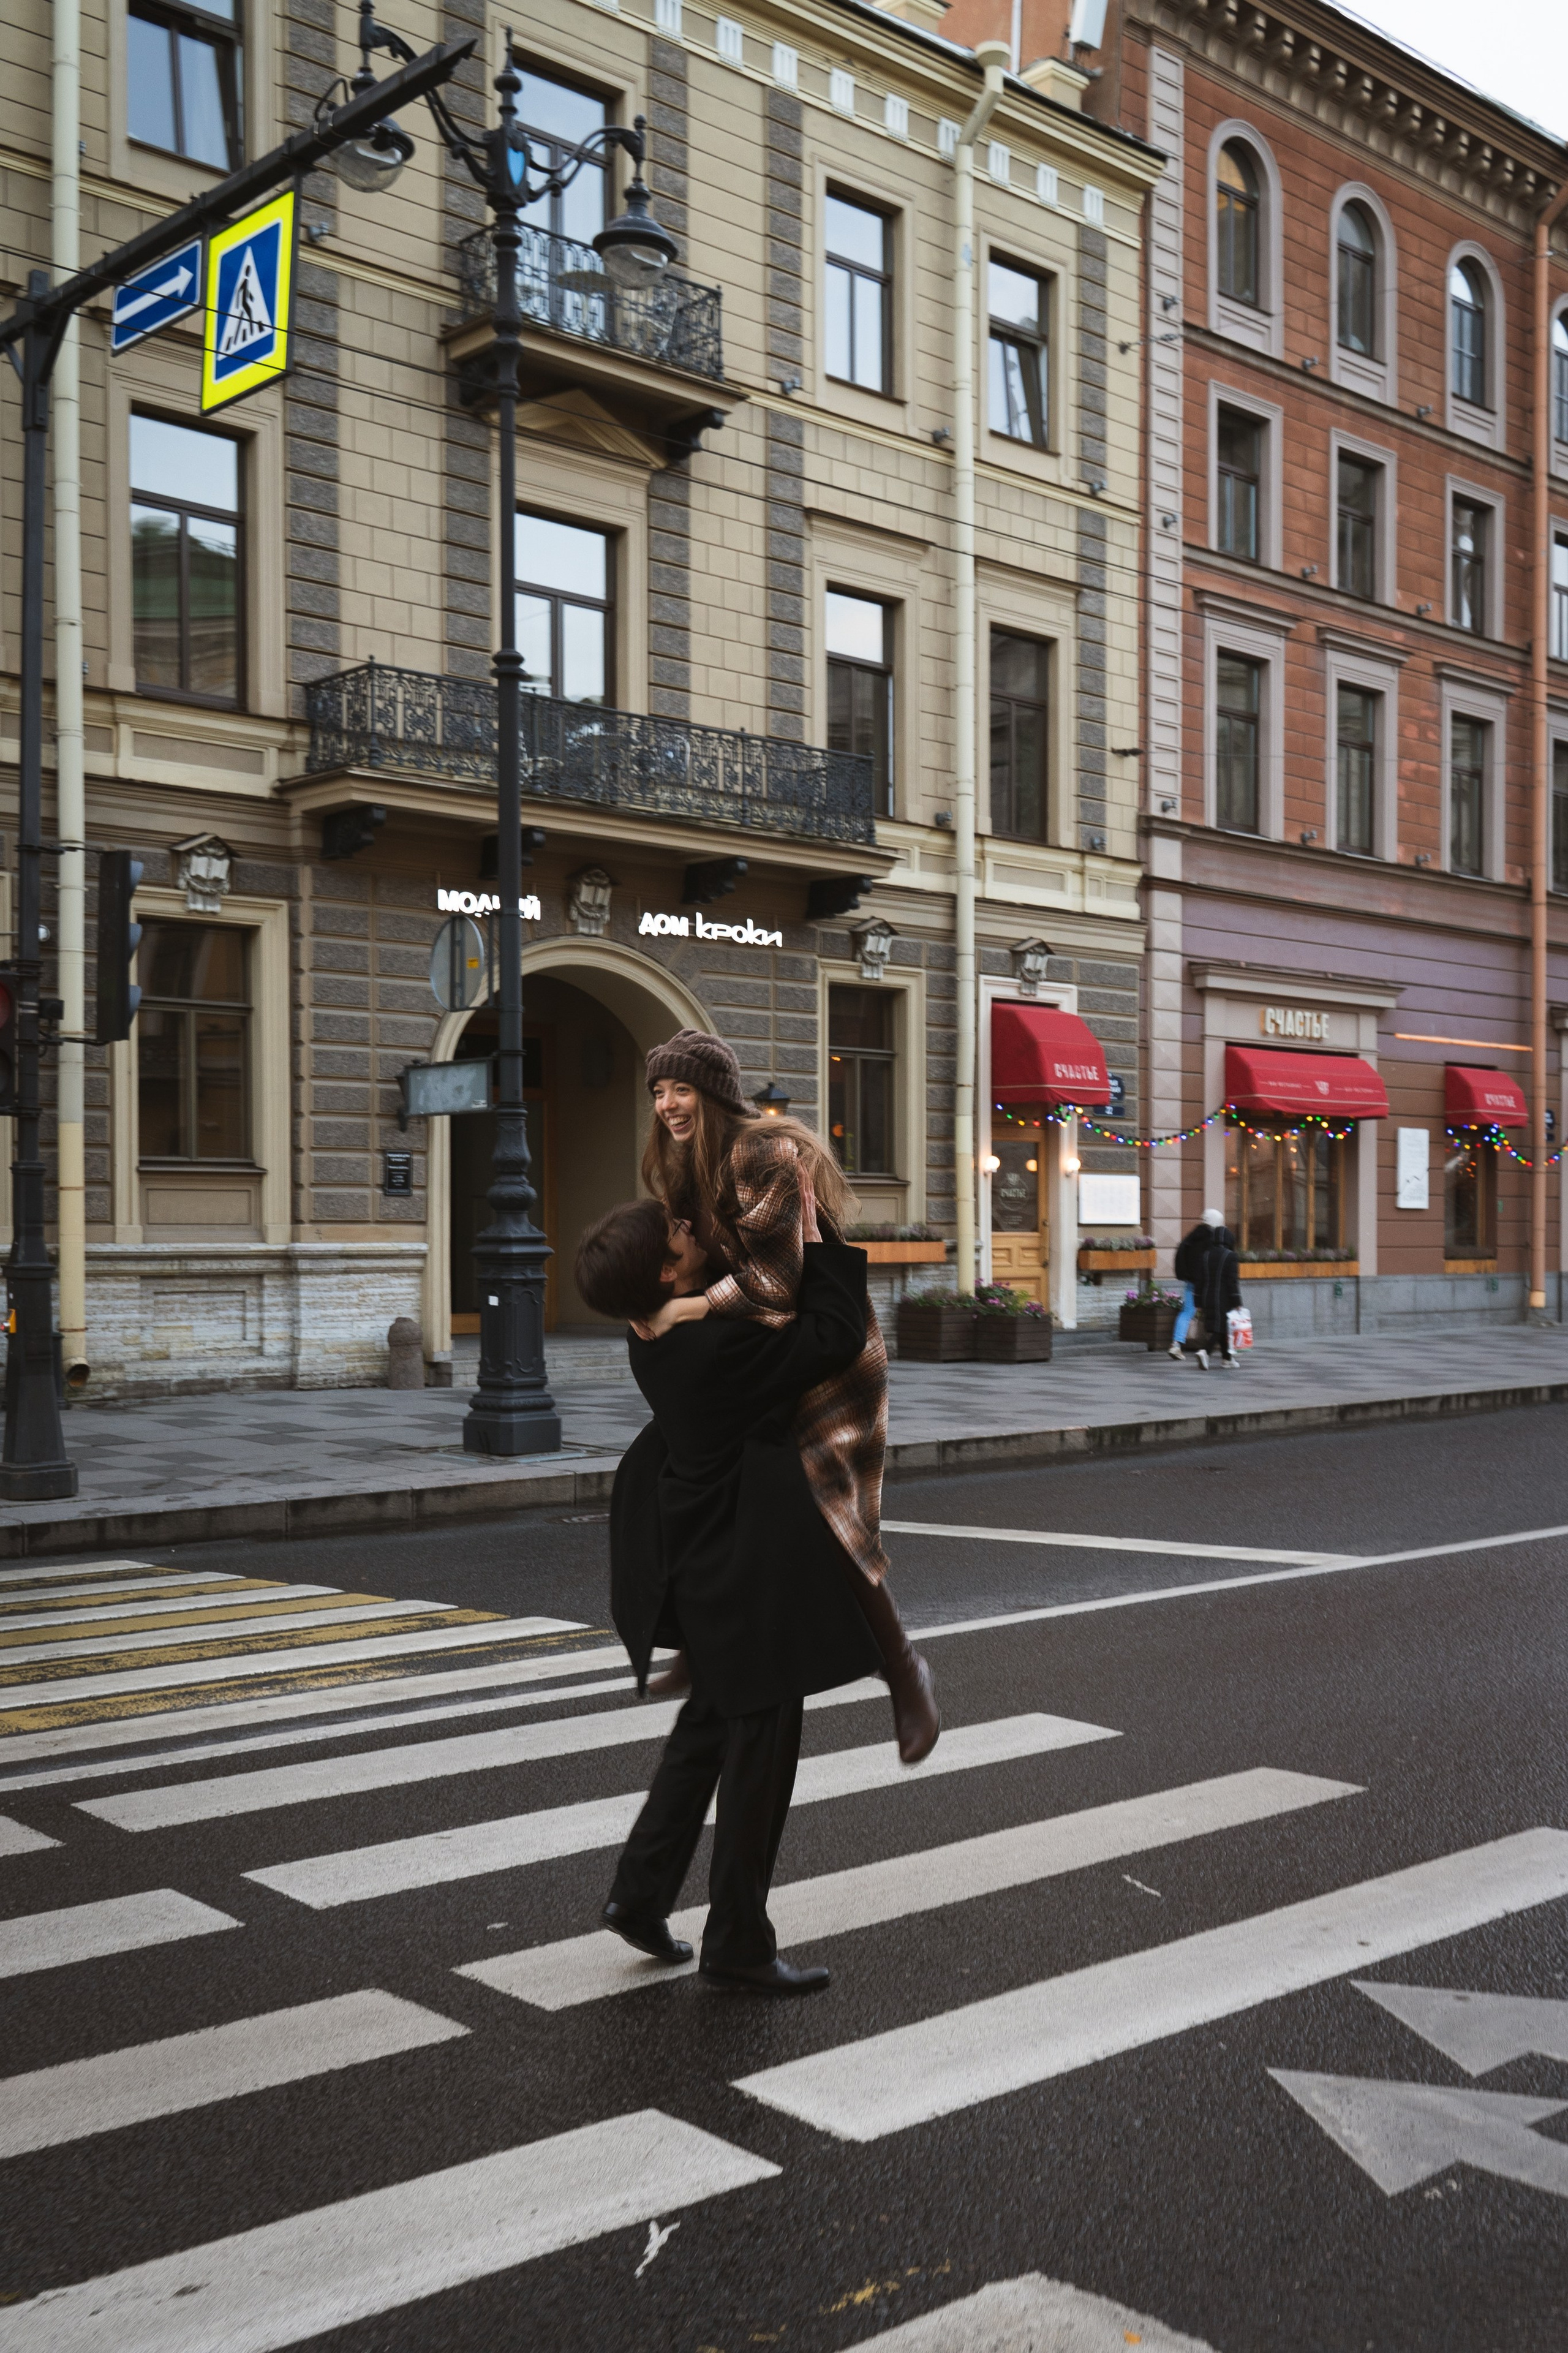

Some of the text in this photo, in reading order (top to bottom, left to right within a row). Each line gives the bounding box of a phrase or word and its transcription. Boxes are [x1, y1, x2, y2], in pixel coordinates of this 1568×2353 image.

[638, 912, 689, 937] ДОМ
[1264, 1007, 1330, 1039] СЧАСТЬЕ
[1054, 1063, 1100, 1081] СЧАСТЬЕ
